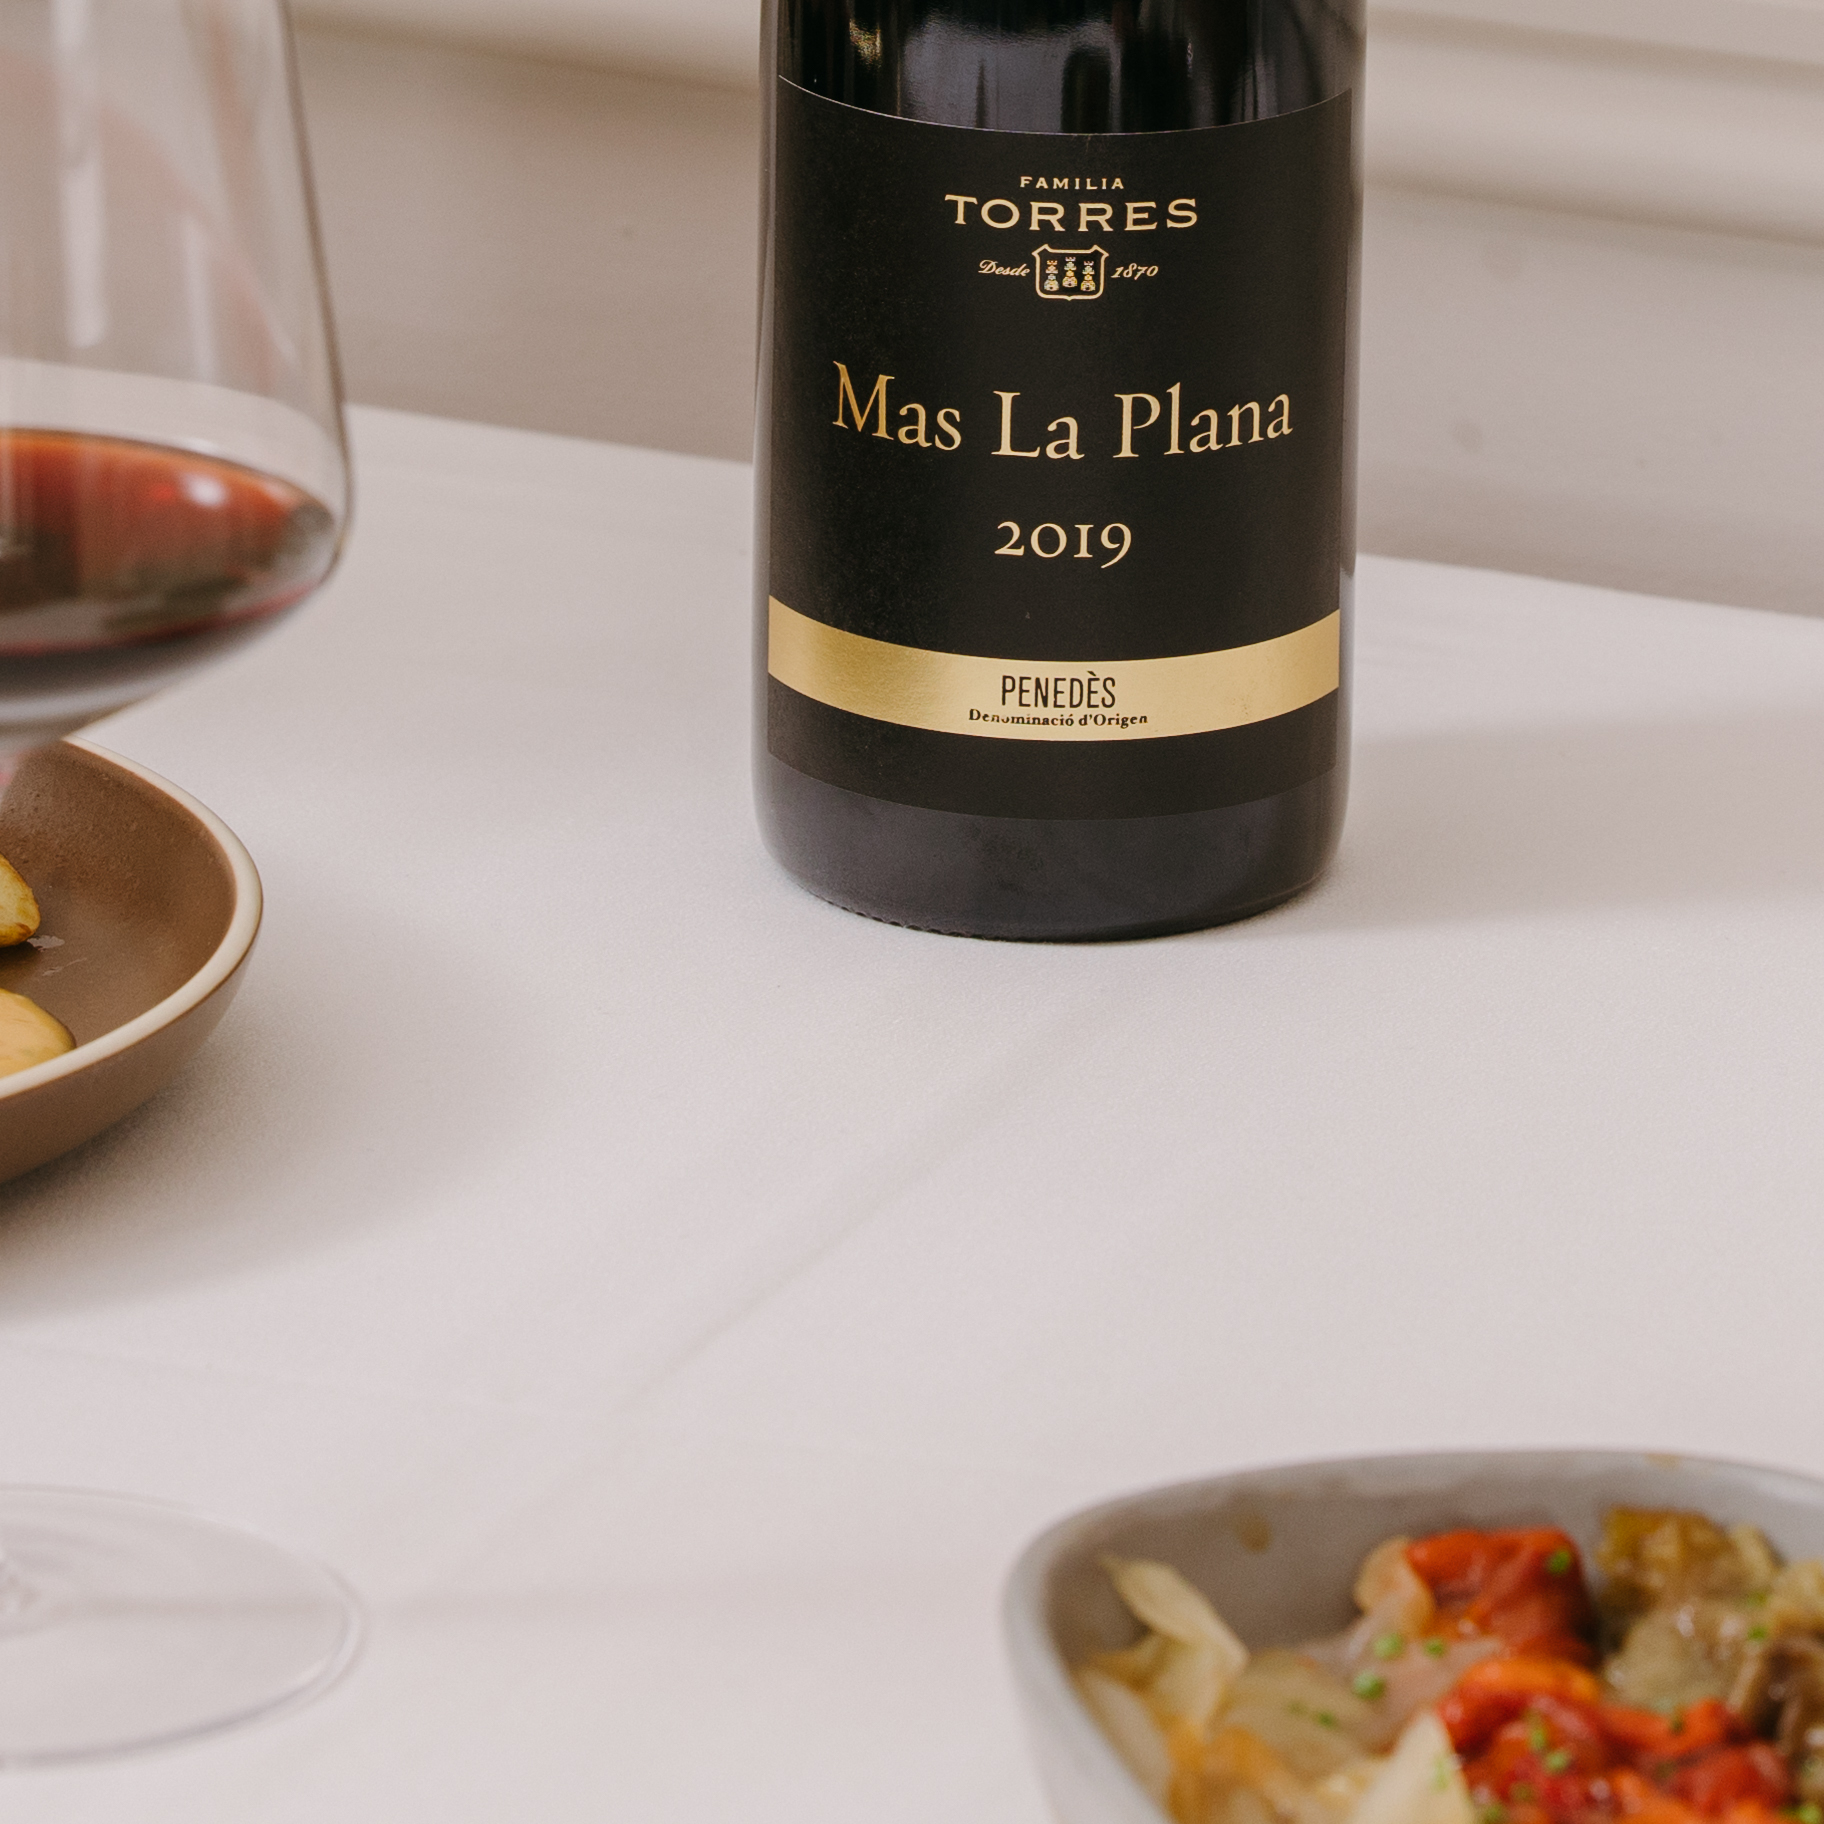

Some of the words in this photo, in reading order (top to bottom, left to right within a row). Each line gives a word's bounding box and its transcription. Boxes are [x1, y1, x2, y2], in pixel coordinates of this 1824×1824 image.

[1019, 176, 1125, 191] FAMILIA
[944, 194, 1199, 232] TORRES
[978, 259, 1031, 277] Desde
[1110, 263, 1159, 281] 1870
[832, 360, 963, 451] Mas
[991, 390, 1086, 460] La
[1112, 382, 1294, 458] Plana
[994, 520, 1133, 569] 2019
[1001, 670, 1116, 709] PENEDÈS
[968, 708, 1074, 727] Denominació
[1078, 713, 1149, 730] d'Origen
